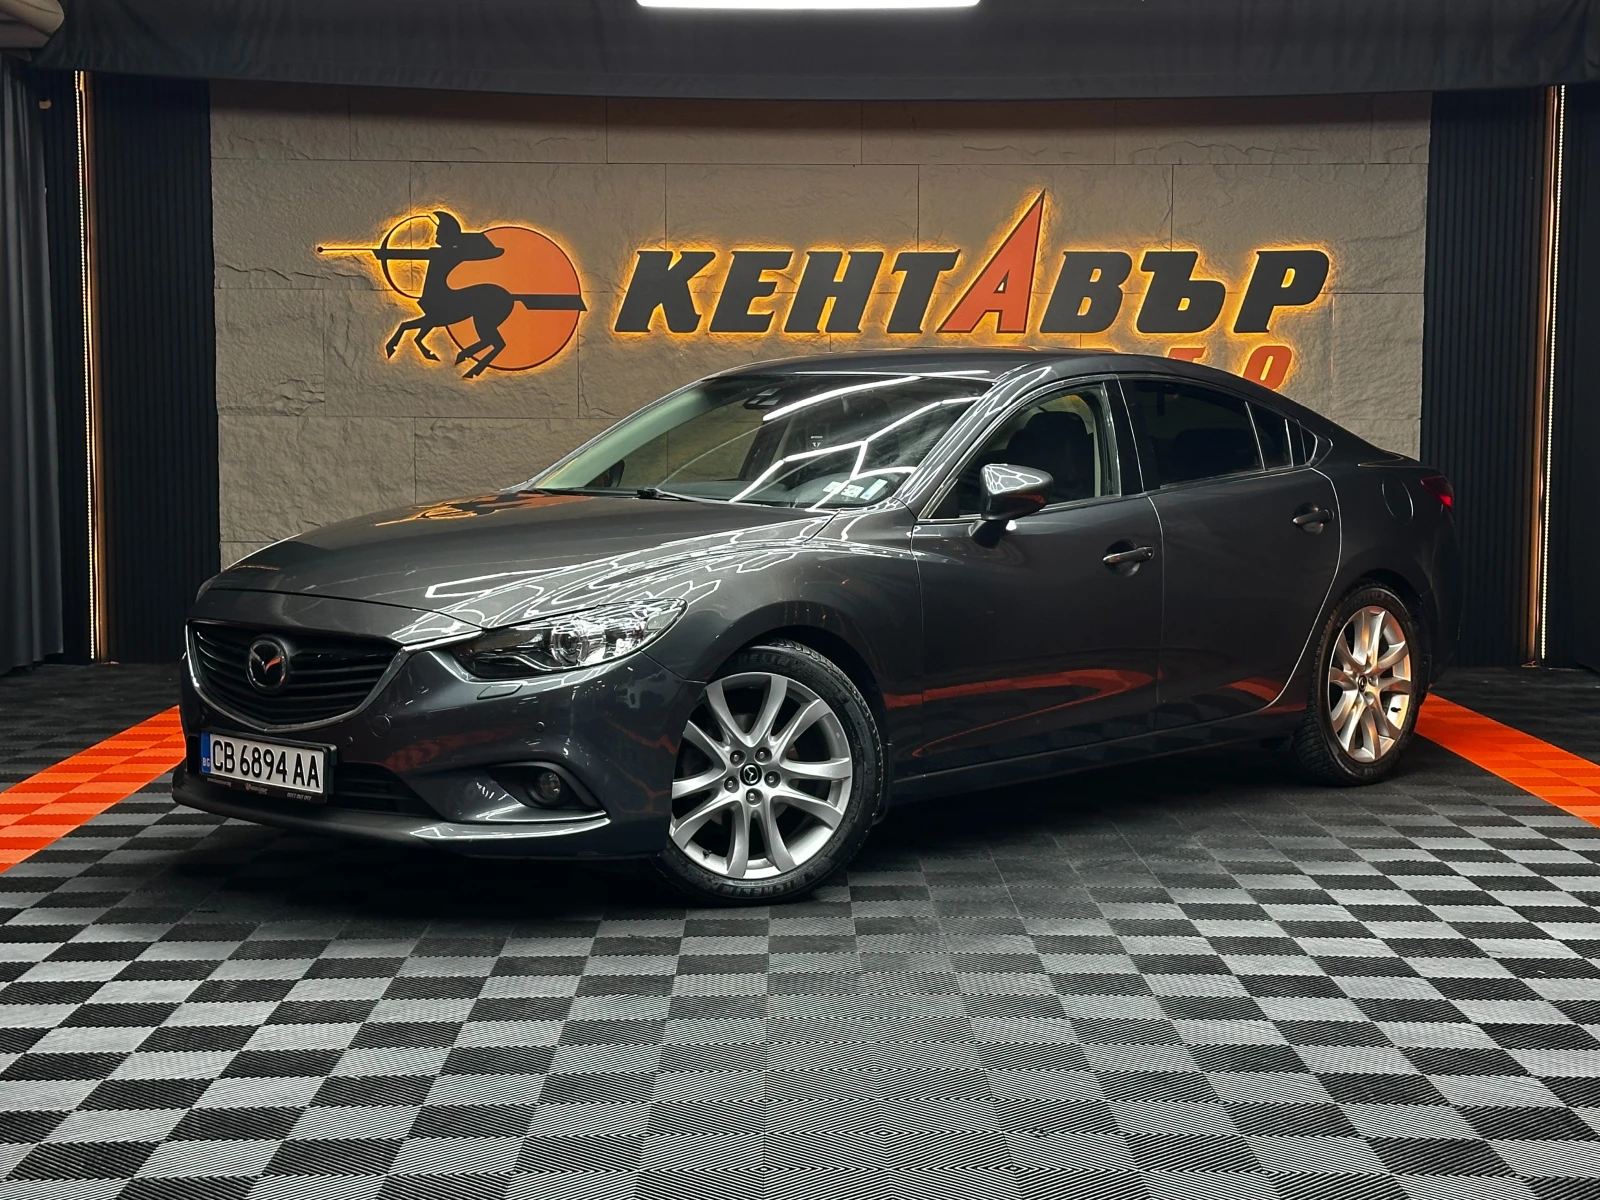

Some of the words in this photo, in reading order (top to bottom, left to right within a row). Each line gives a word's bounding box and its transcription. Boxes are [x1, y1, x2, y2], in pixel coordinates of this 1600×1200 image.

[613, 189, 1330, 333] КЕНТАВЪР
[202, 757, 211, 767] BG
[240, 745, 287, 783] 6894
[292, 753, 320, 788] AA
